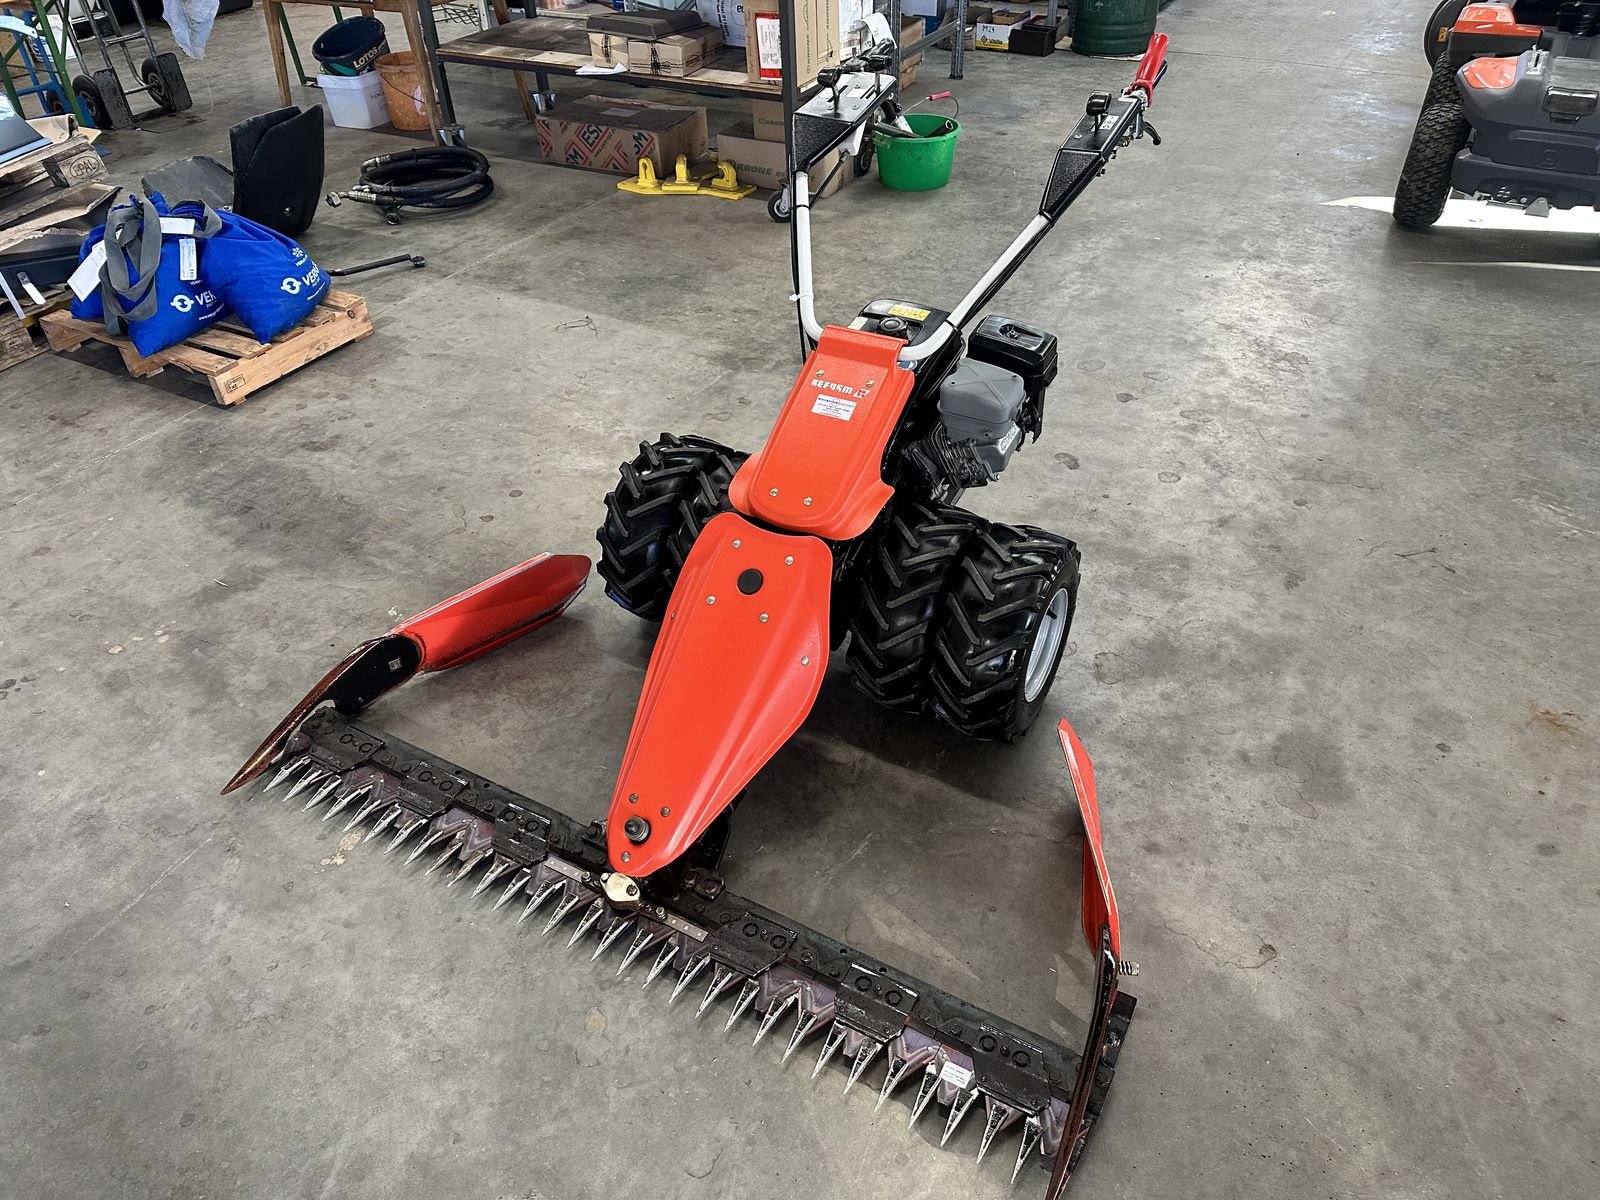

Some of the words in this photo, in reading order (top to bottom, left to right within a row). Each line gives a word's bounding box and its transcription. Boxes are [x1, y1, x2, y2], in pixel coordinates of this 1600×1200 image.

[982, 25, 995, 33] M24
[352, 46, 378, 68] LOTOS
[736, 163, 773, 176] KRONE
[810, 378, 854, 395] REFORM
